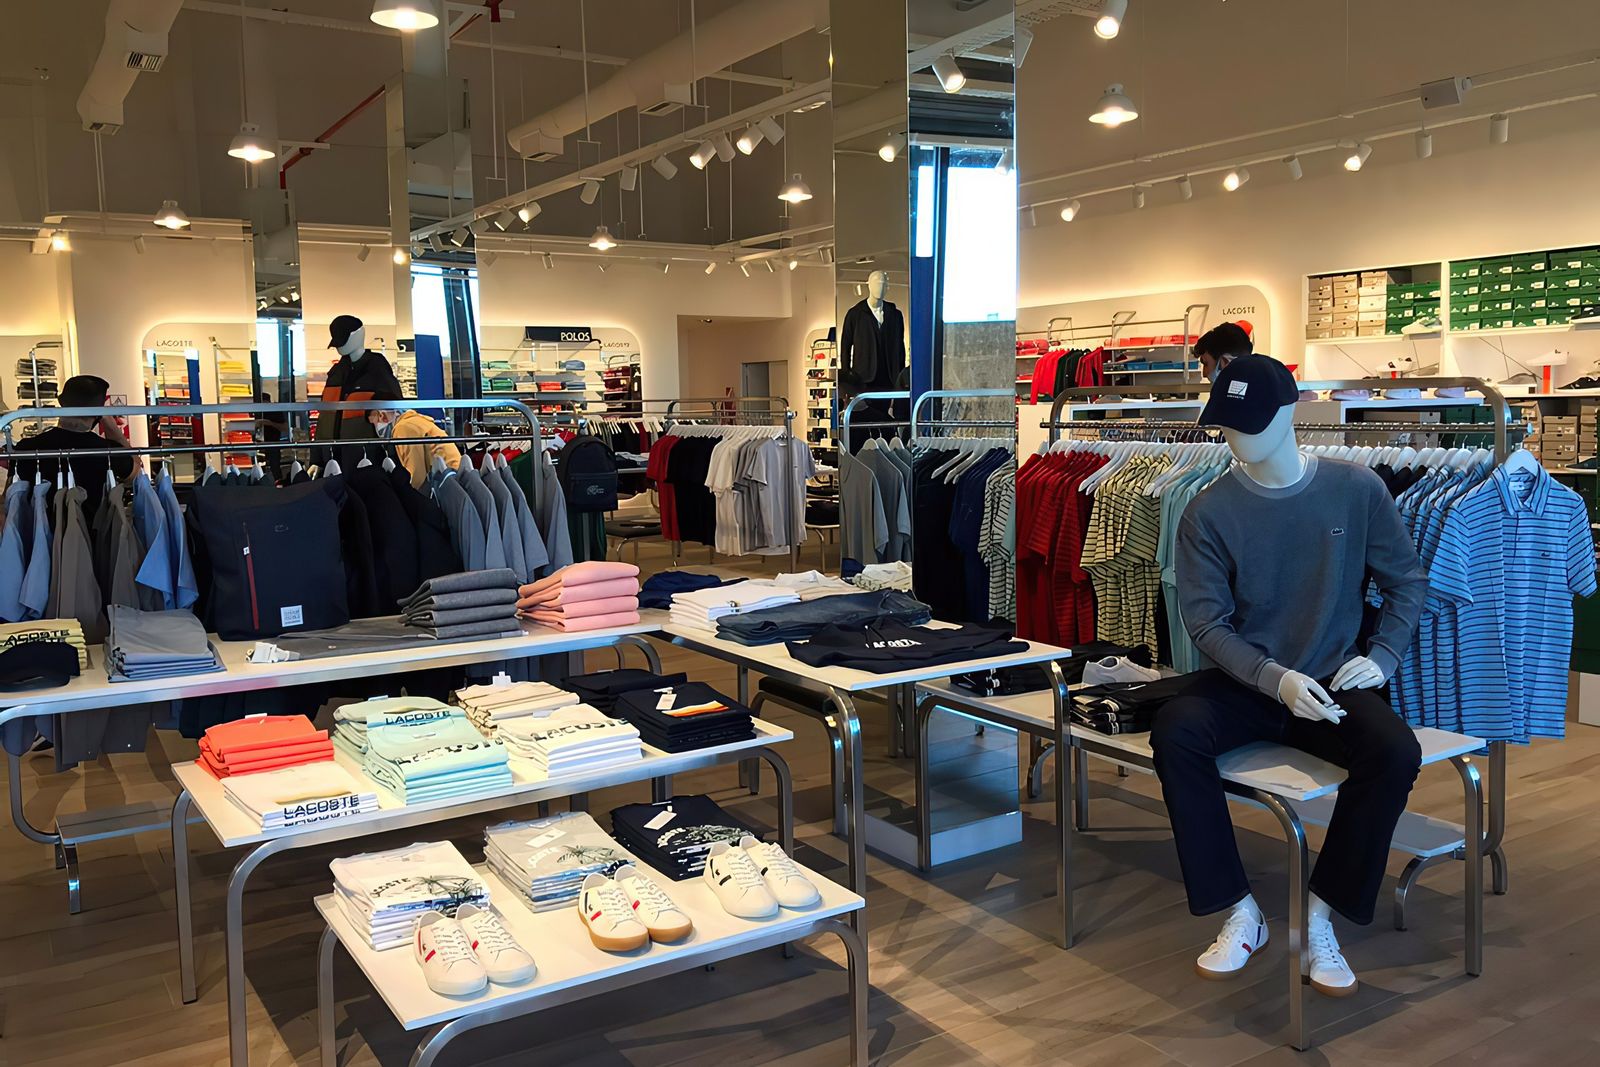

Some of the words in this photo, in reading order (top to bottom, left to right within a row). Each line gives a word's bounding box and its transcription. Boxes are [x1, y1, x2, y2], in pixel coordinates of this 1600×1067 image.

[1222, 306, 1255, 315] LACOSTE
[560, 332, 590, 342] POLOS
[385, 710, 451, 725] LACOSTE
